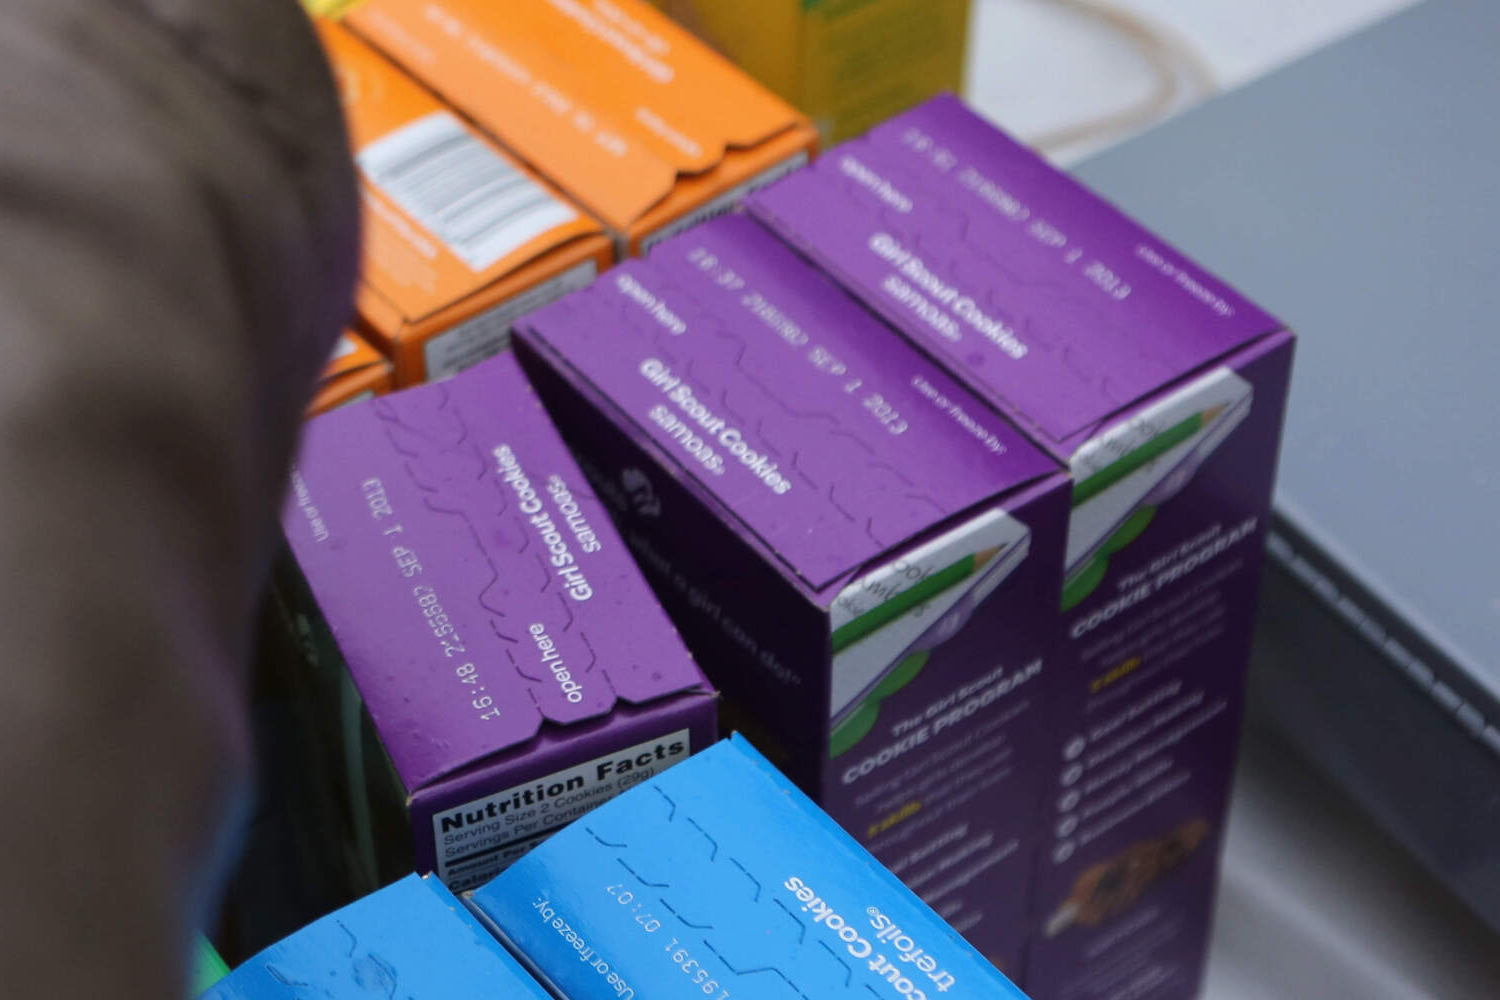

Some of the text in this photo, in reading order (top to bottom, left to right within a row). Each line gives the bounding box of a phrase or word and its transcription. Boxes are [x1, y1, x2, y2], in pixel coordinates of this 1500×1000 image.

[903, 256, 959, 304] Scout
[953, 296, 1028, 359] Cookies
[639, 357, 792, 495] Girl Scout Cookies
[862, 393, 909, 435] 2013
[362, 476, 393, 520] 2013
[493, 443, 593, 601] Girl Scout Cookies
[392, 546, 423, 578] SEP
[1070, 582, 1152, 639] COOKIE
[1154, 515, 1258, 591] PROGRAM
[456, 662, 501, 721] 16:48
[530, 622, 582, 703] open here
[841, 727, 930, 785] COOKIE
[932, 657, 1043, 735] PROGRAM
[441, 741, 685, 833] Nutrition Facts
[444, 768, 655, 846] Serving Size 2 Cookies (29g)
[445, 829, 510, 858] Servings
[514, 818, 538, 835] Per
[448, 854, 499, 876] Amount
[532, 896, 556, 923] by:
[552, 918, 596, 962] freeze
[784, 877, 927, 1000] cout Cookies
[590, 957, 609, 975] or
